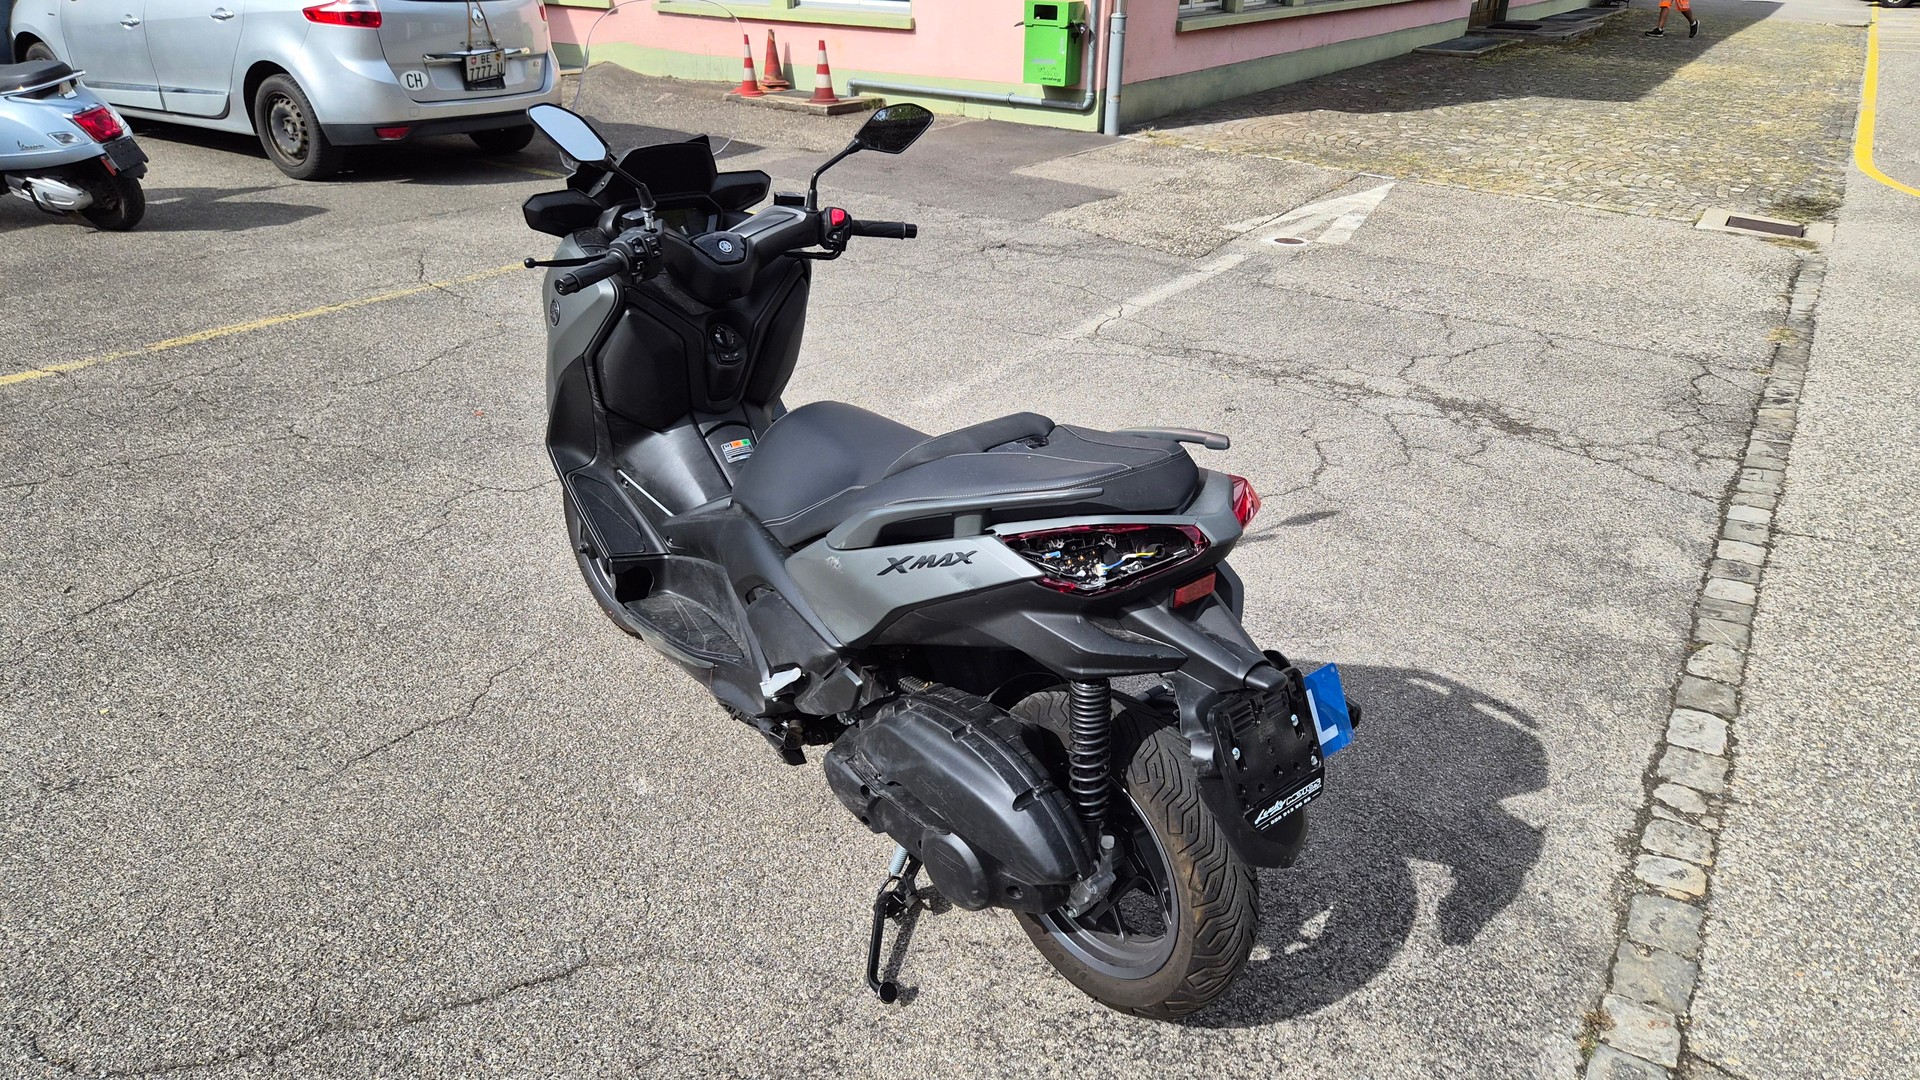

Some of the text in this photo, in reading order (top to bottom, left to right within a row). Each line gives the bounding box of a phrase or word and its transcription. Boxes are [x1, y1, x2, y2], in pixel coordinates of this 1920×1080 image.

[480, 54, 491, 64] BE
[406, 73, 424, 89] CH
[1306, 688, 1339, 746] L
